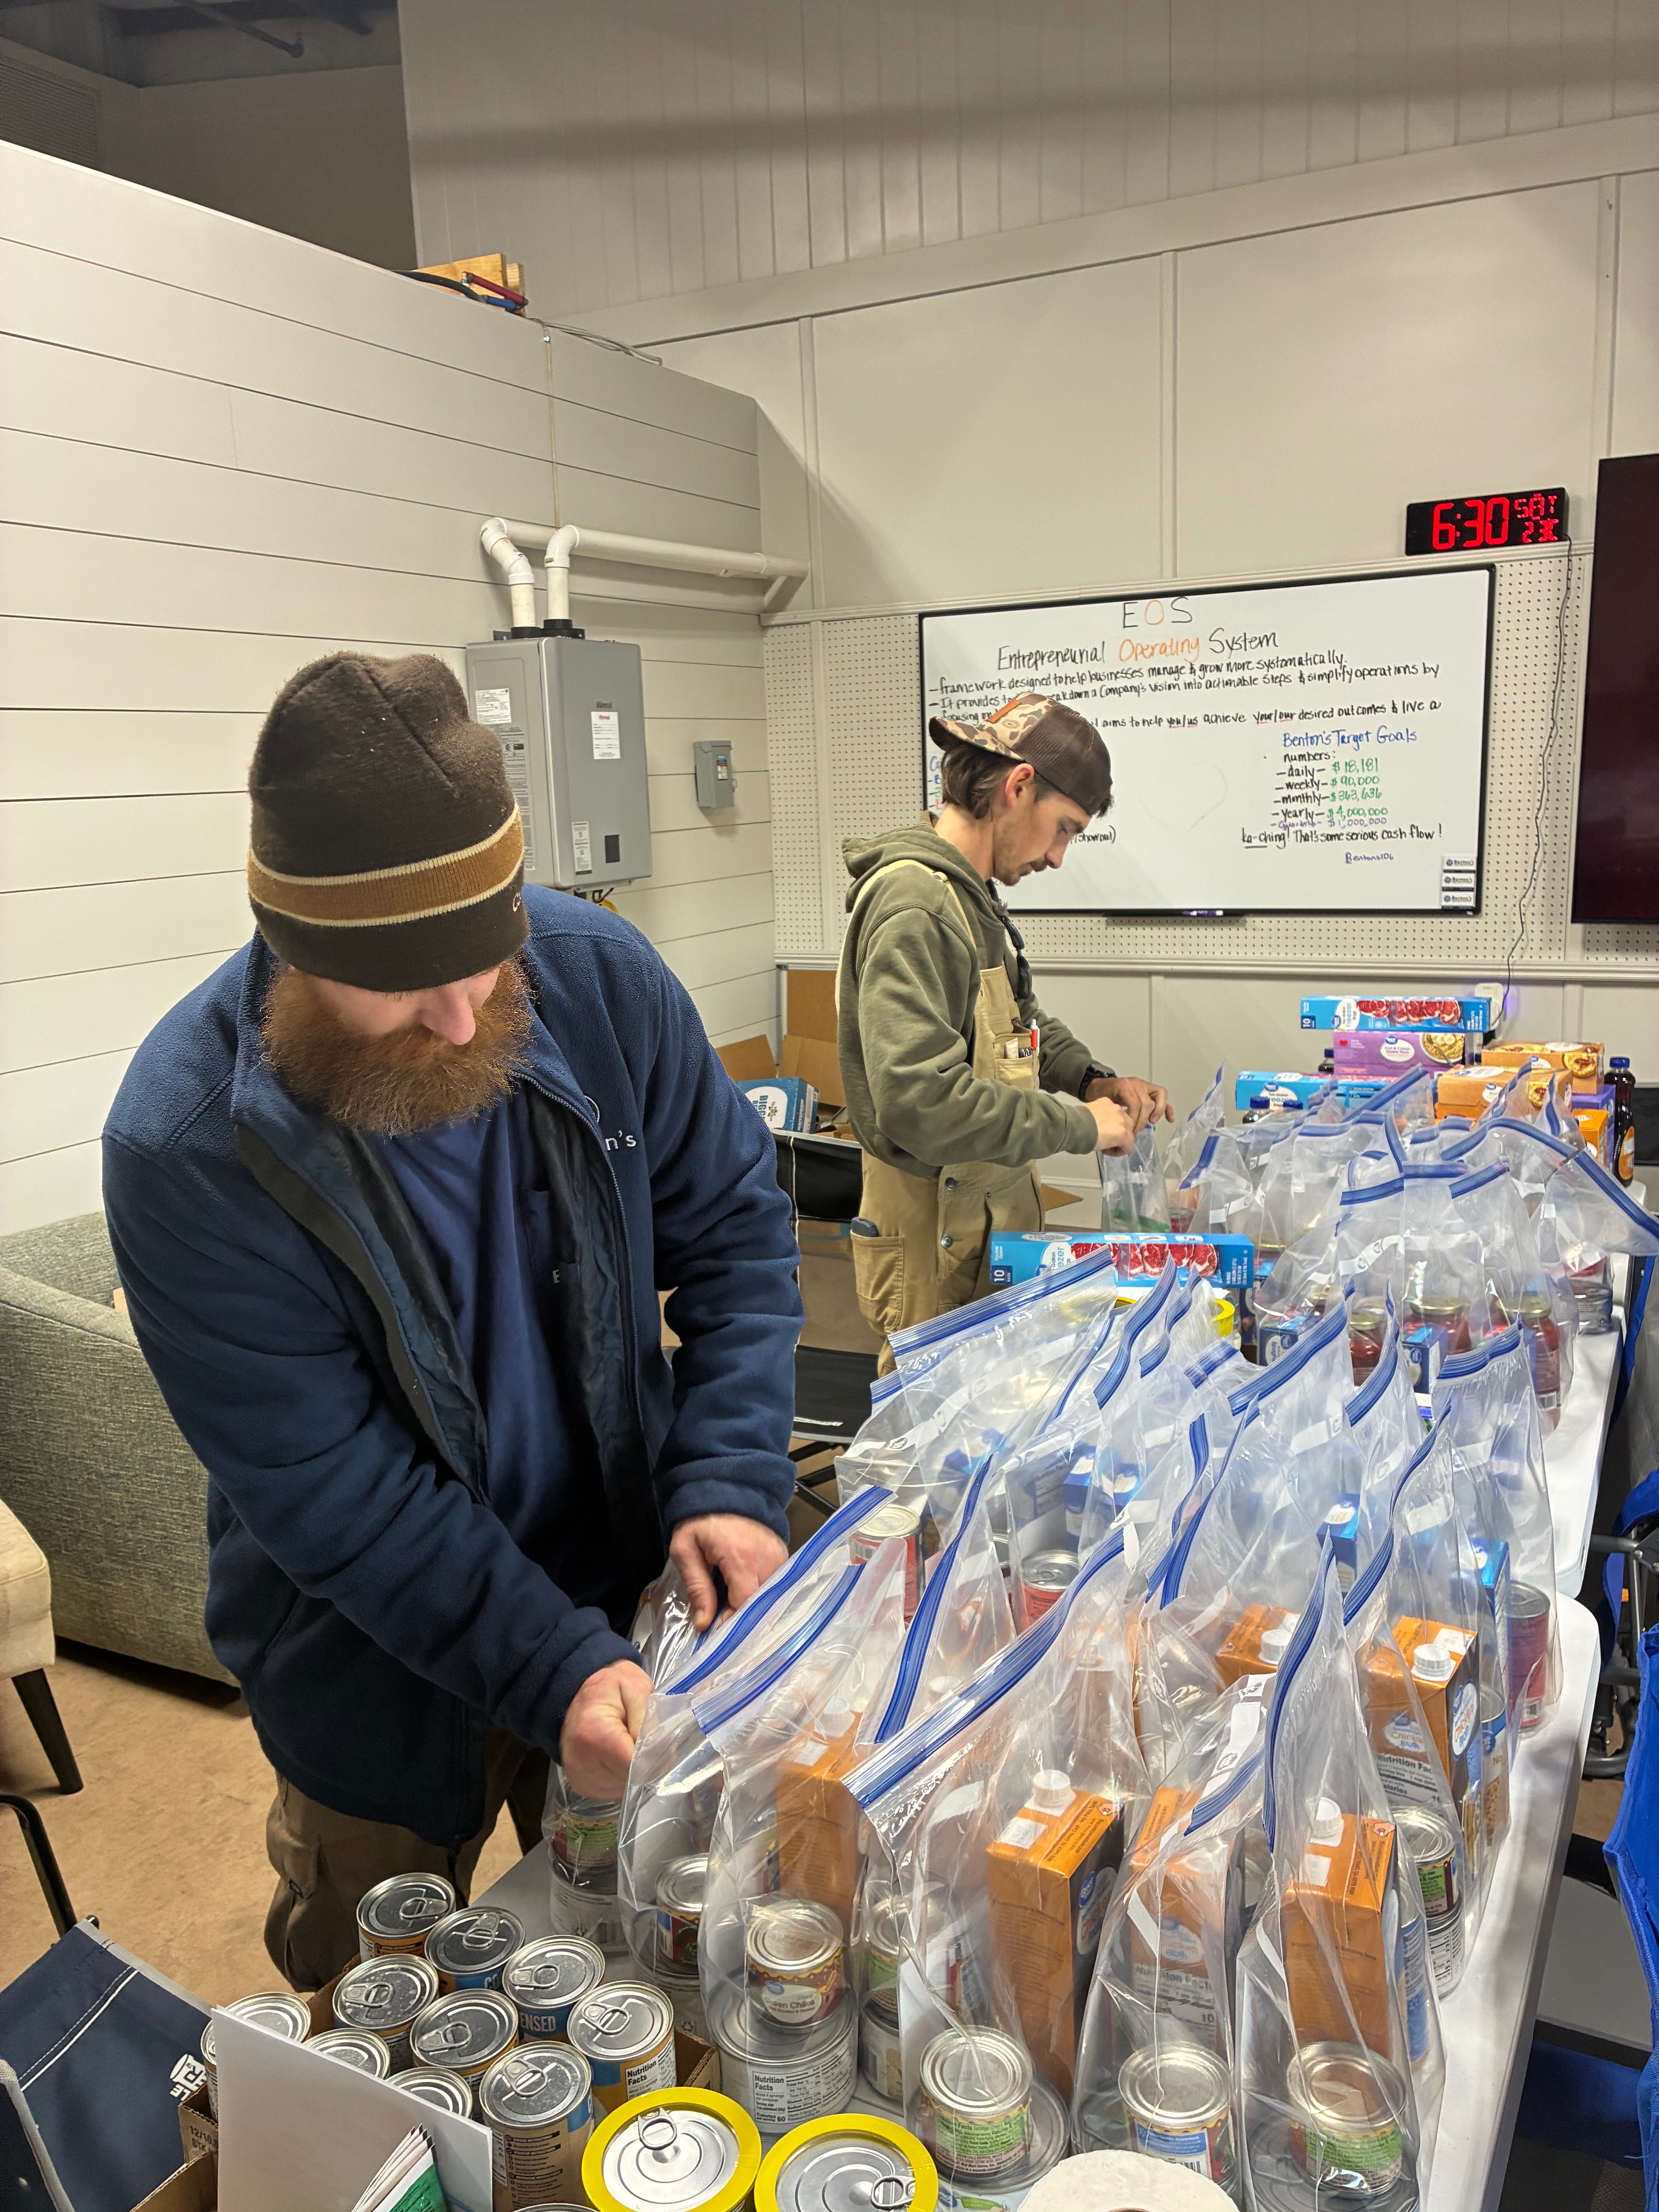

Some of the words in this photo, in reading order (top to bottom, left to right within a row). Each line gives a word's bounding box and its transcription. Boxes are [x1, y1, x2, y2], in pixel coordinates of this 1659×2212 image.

[1432, 497, 1510, 550] 6:30
[1123, 596, 1193, 628] EOS
[998, 641, 1105, 671] Entrepreneurial
[1119, 637, 1200, 663] Operating
[1209, 627, 1279, 658] System
[956, 695, 1000, 709] provides
[1149, 682, 1180, 692] vision
[1184, 678, 1202, 690] into
[1205, 676, 1259, 689] actionable
[1308, 665, 1353, 684] simplify
[1355, 664, 1418, 680] operations
[1422, 662, 1439, 678] by
[1008, 673, 1051, 692] designed
[1065, 672, 1087, 685] help
[1089, 667, 1144, 683] businesses
[1148, 665, 1186, 681] manage
[1198, 663, 1223, 680] grow
[1103, 718, 1126, 727] aims
[1131, 716, 1140, 728] to
[1142, 716, 1163, 728] help
[1203, 713, 1247, 725] achieve
[1298, 707, 1333, 720] desired
[1403, 700, 1424, 714] live
[1283, 731, 1331, 747] Benton's
[1331, 729, 1372, 751] Target
[1377, 725, 1417, 744] Goals
[1320, 833, 1344, 842] some
[1346, 829, 1379, 841] serious
[1381, 828, 1407, 840] cash
[758, 1095, 768, 1121] BIGG
[994, 1270, 1005, 1282] 10
[1383, 1784, 1407, 1794] alories
[520, 2013, 556, 2032] ENSED
[627, 2061, 656, 2078] Nutrition
[628, 2075, 647, 2085] Facts
[755, 2075, 784, 2083] Nutrition
[755, 2082, 774, 2091] Facts
